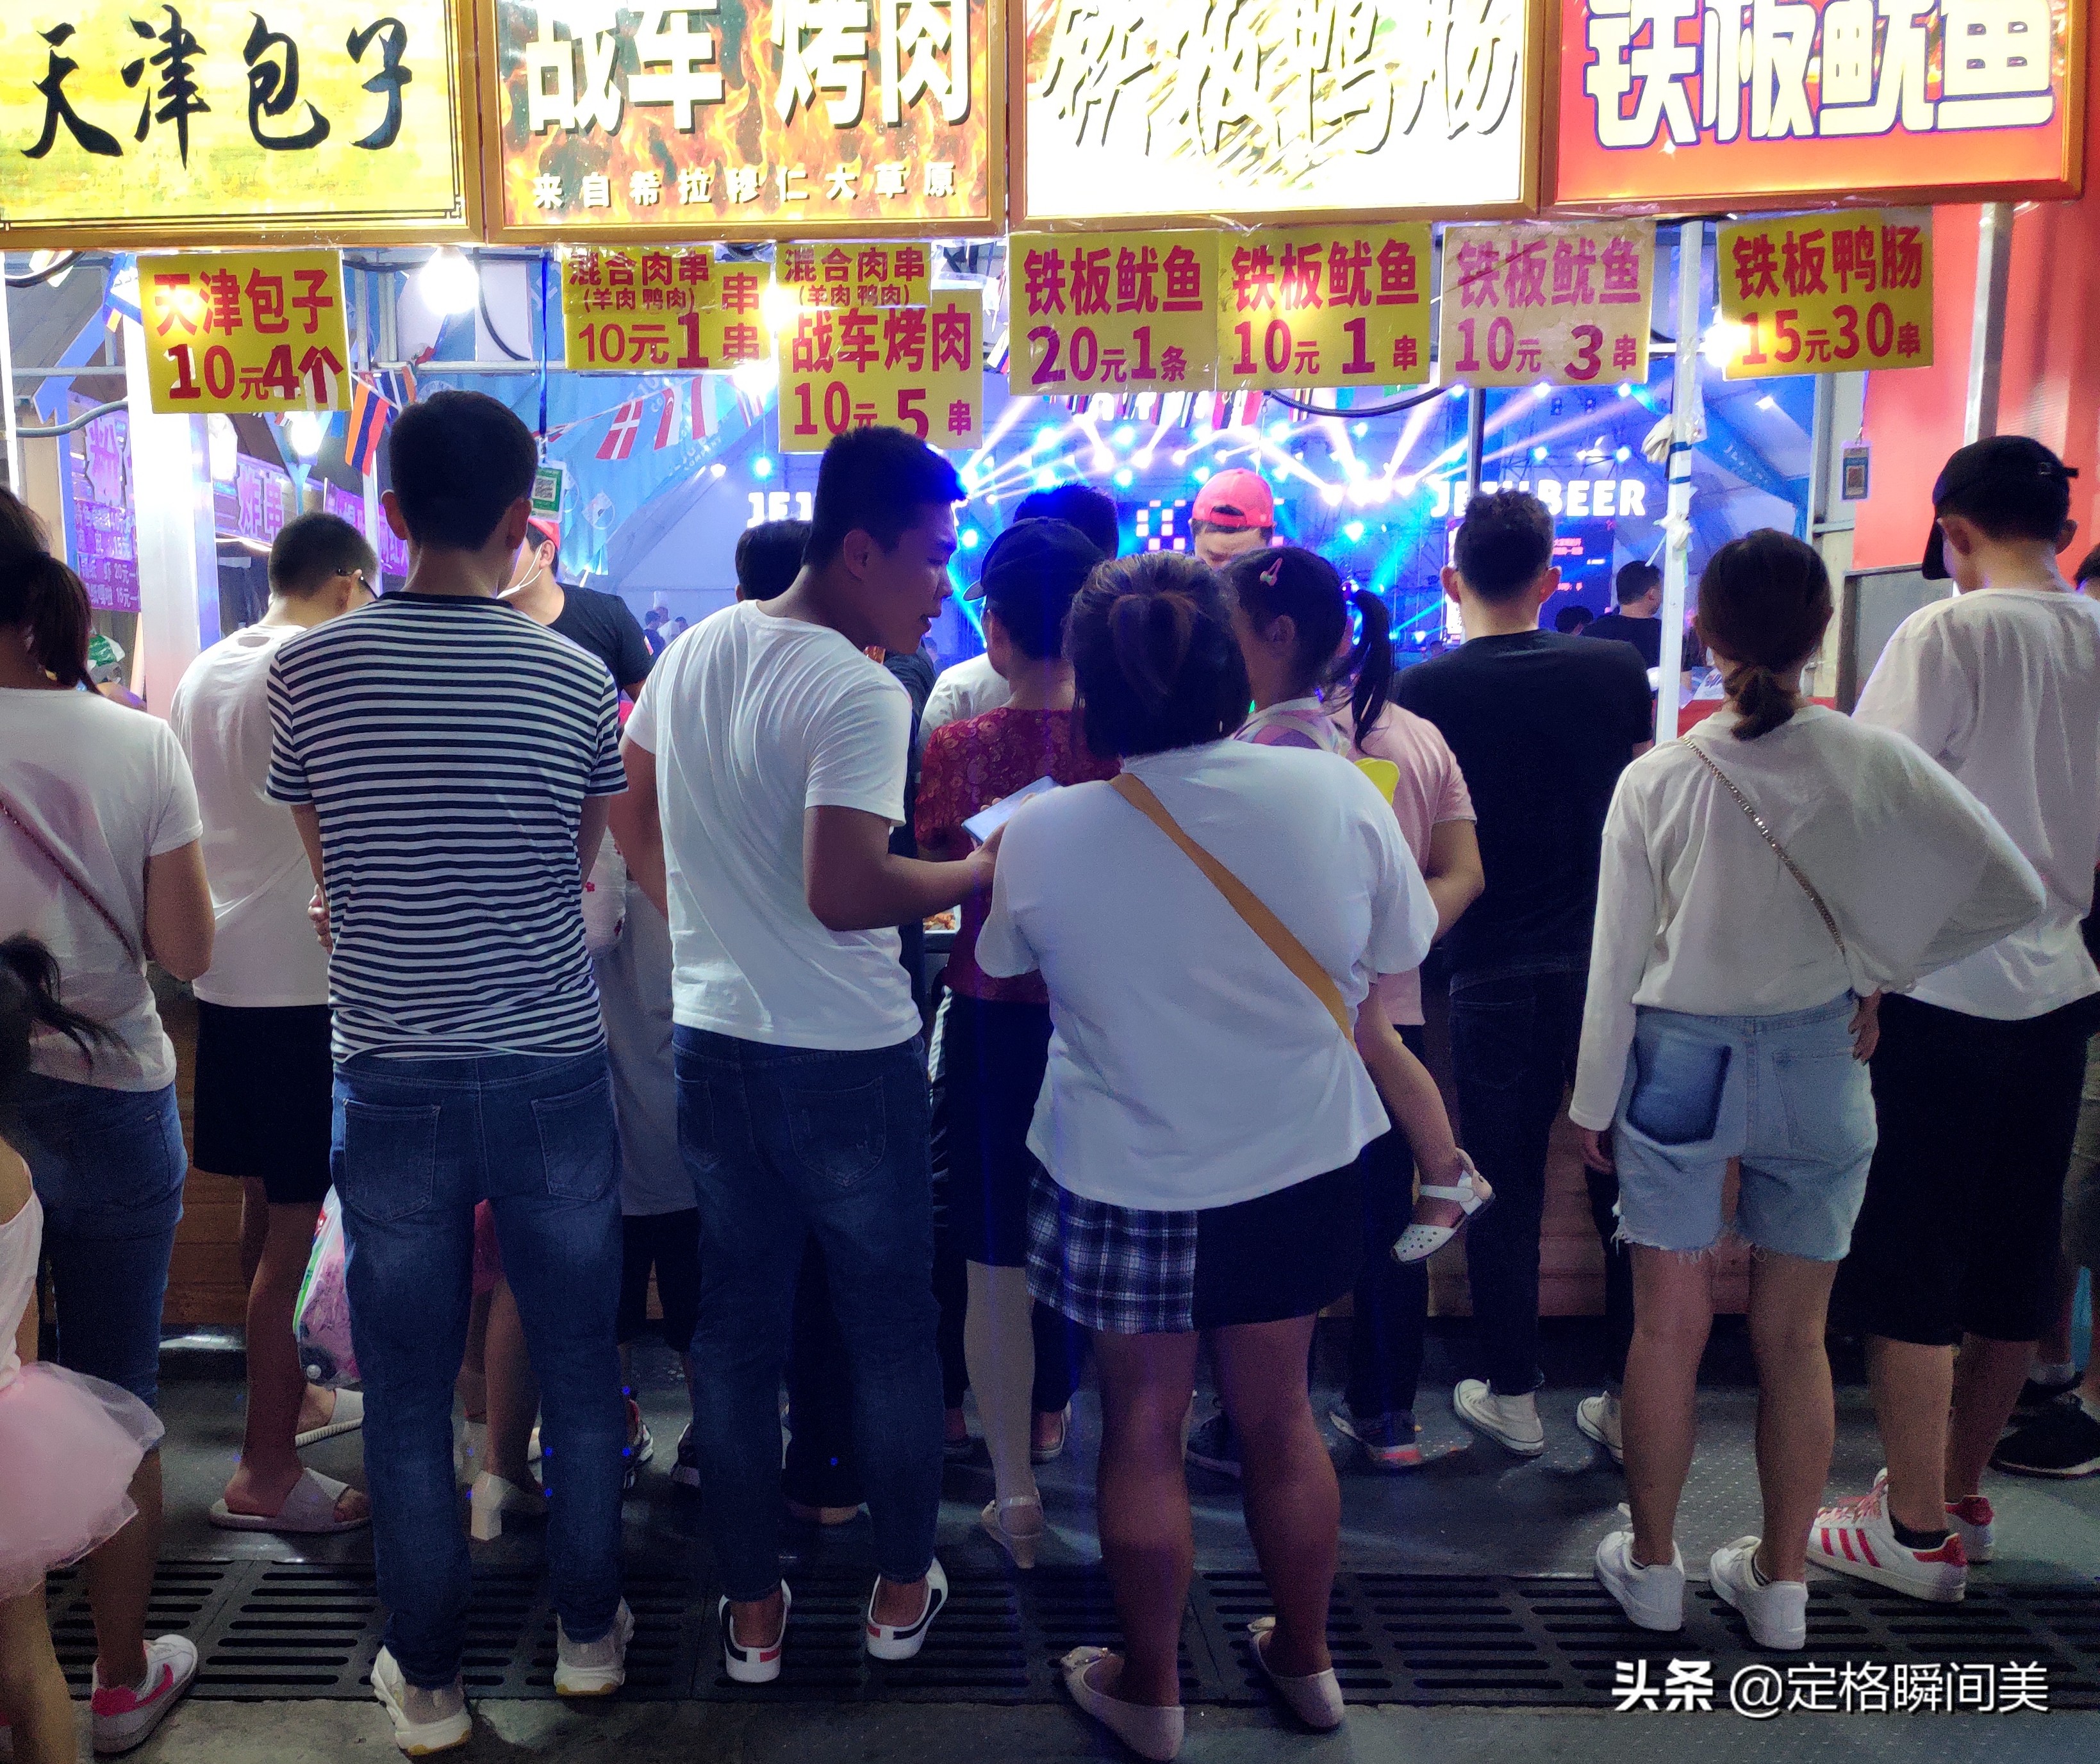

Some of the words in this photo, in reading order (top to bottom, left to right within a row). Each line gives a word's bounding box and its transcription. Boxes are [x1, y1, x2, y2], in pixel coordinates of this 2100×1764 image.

[21, 4, 413, 170] 天津包子
[568, 250, 709, 286] 混合肉串
[784, 247, 925, 282] 混合肉串
[1024, 245, 1203, 316] 铁板鱿鱼
[1231, 238, 1419, 313] 铁板鱿鱼
[1456, 237, 1641, 309] 铁板鱿鱼
[1732, 224, 1923, 301] 铁板鸭肠
[154, 267, 333, 336] 天津包子
[792, 302, 971, 373] 战车烤肉
[1538, 479, 1646, 516] BEER
